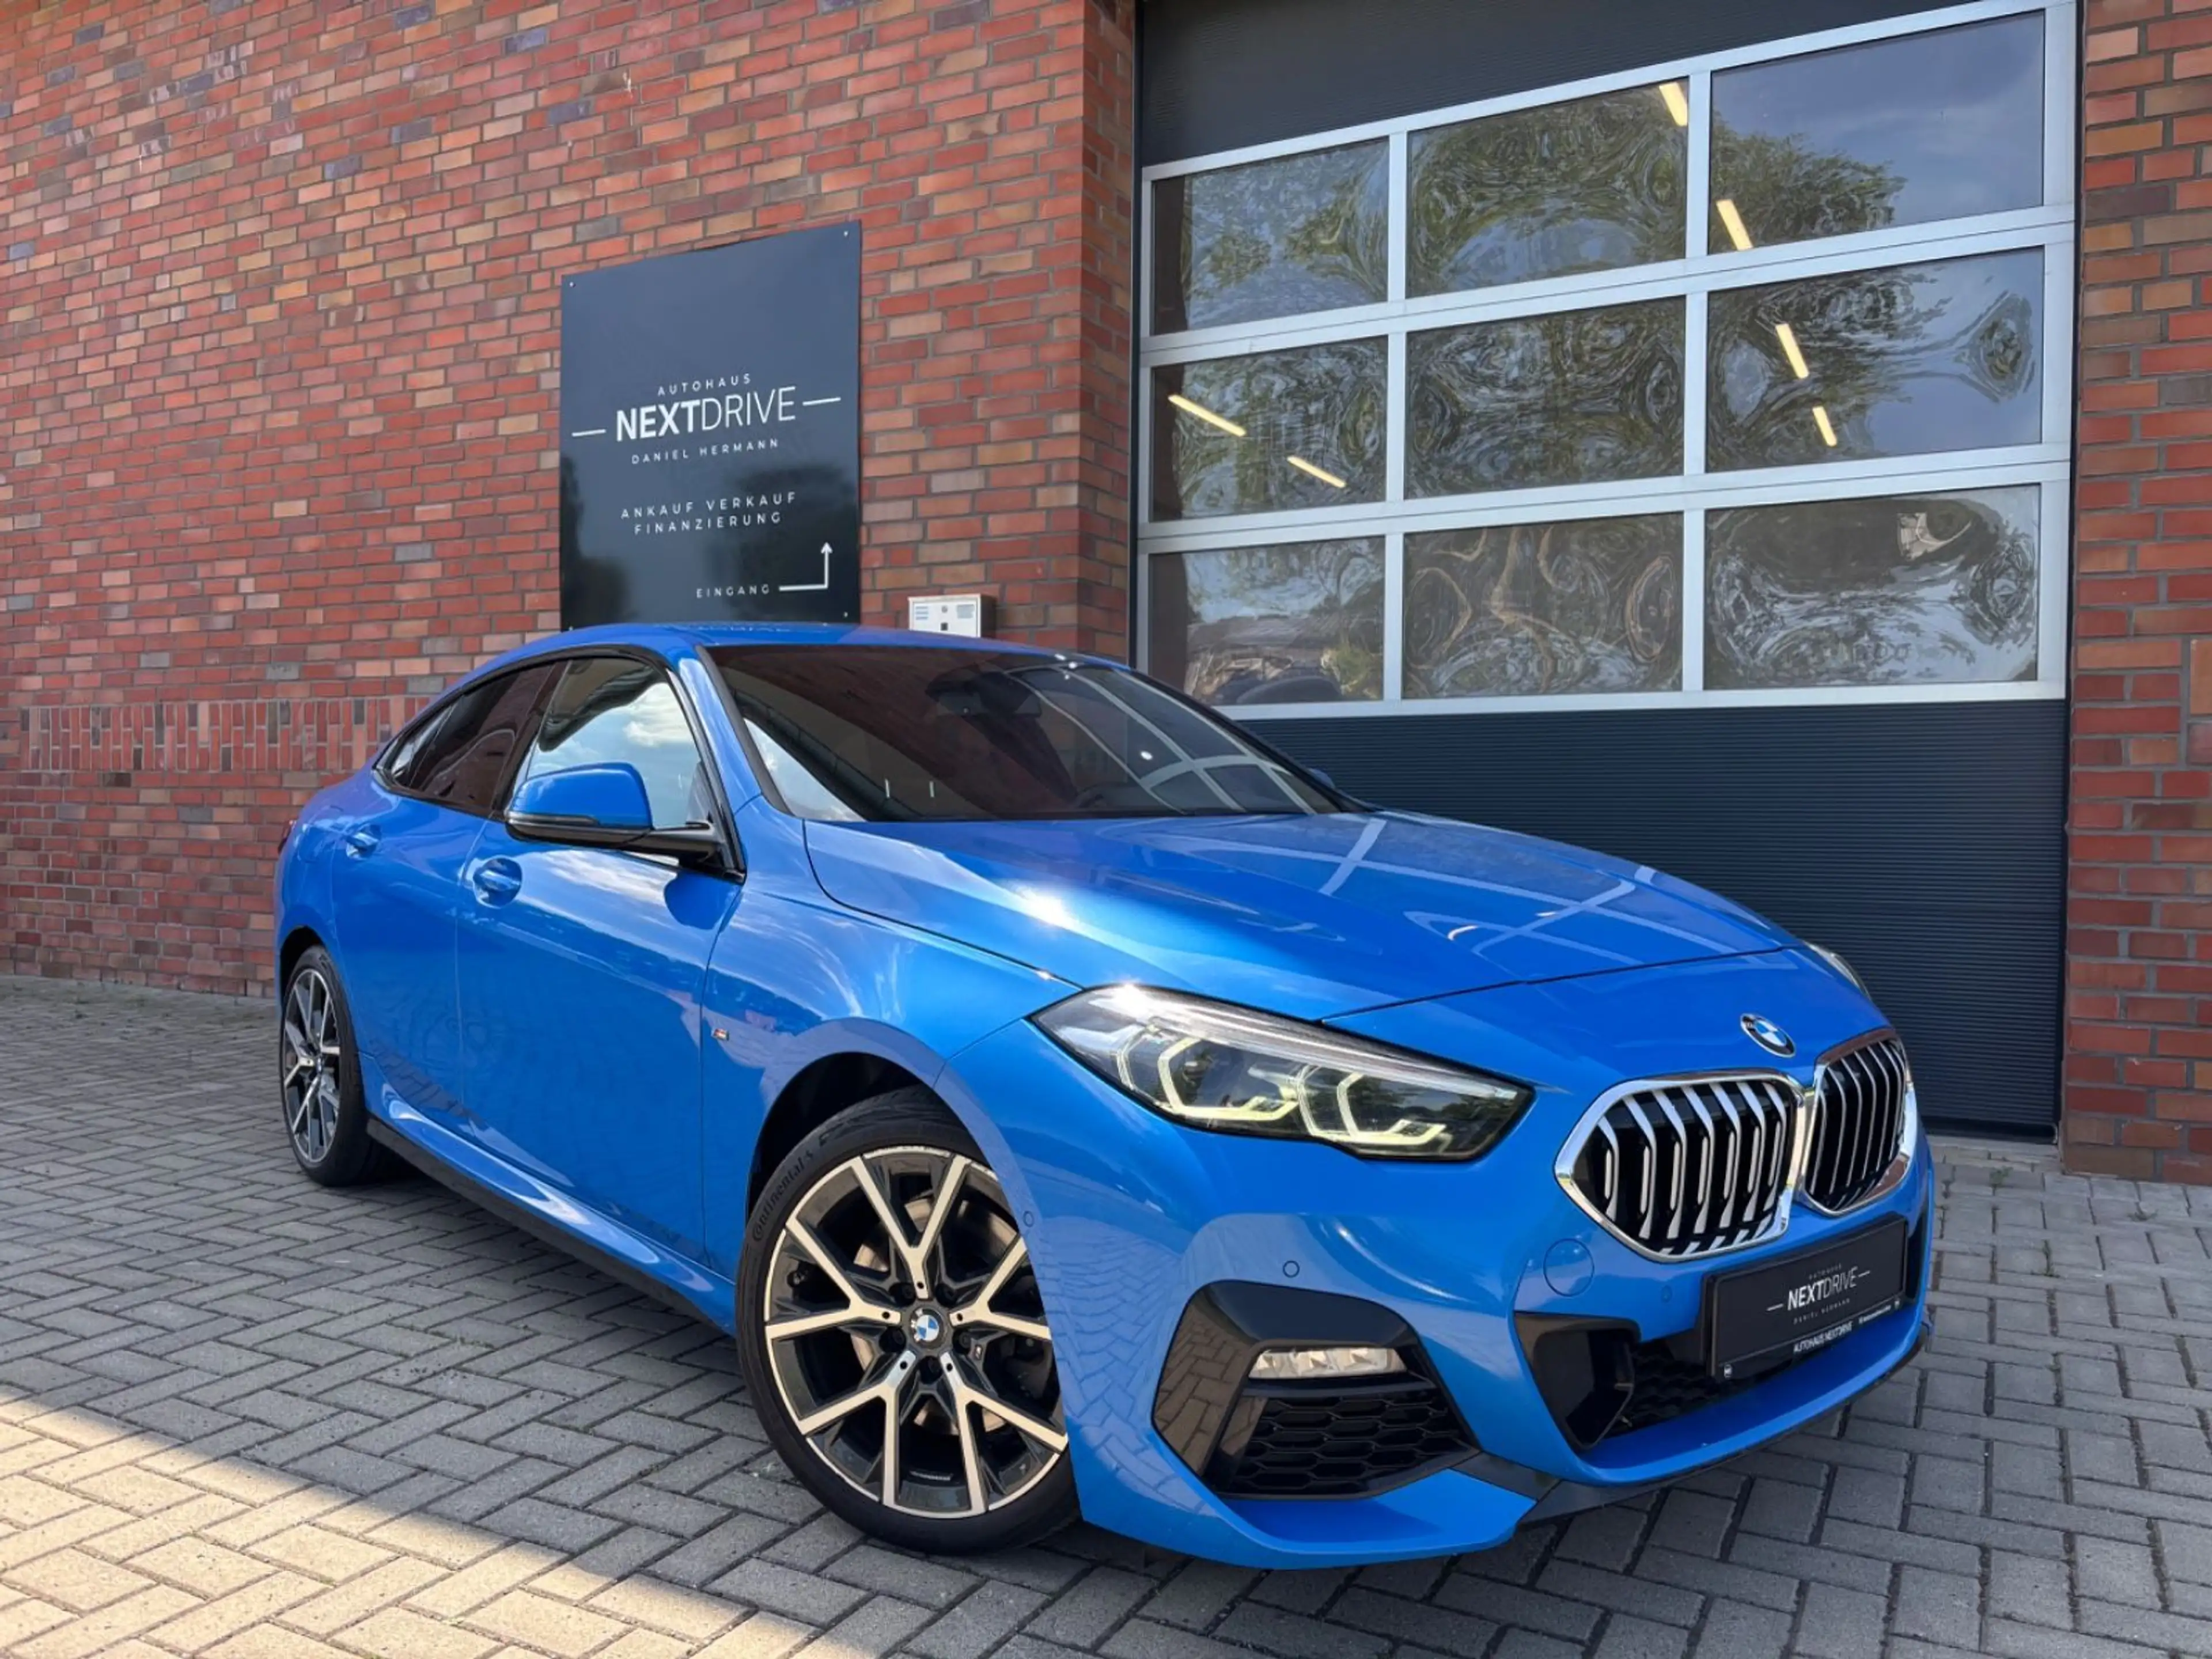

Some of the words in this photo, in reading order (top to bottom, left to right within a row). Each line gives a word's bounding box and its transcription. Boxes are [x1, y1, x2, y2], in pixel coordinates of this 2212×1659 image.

[657, 373, 751, 396] AUTOHAUS
[616, 386, 797, 442] NEXTDRIVE
[631, 449, 689, 464] DANIEL
[699, 438, 778, 457] HERMANN
[621, 501, 694, 520] ANKAUF
[706, 491, 797, 512] VERKAUF
[634, 512, 782, 535] FINANZIERUNG
[696, 584, 770, 598] EINGANG
[1787, 1266, 1858, 1311] NEXTDRIVE
